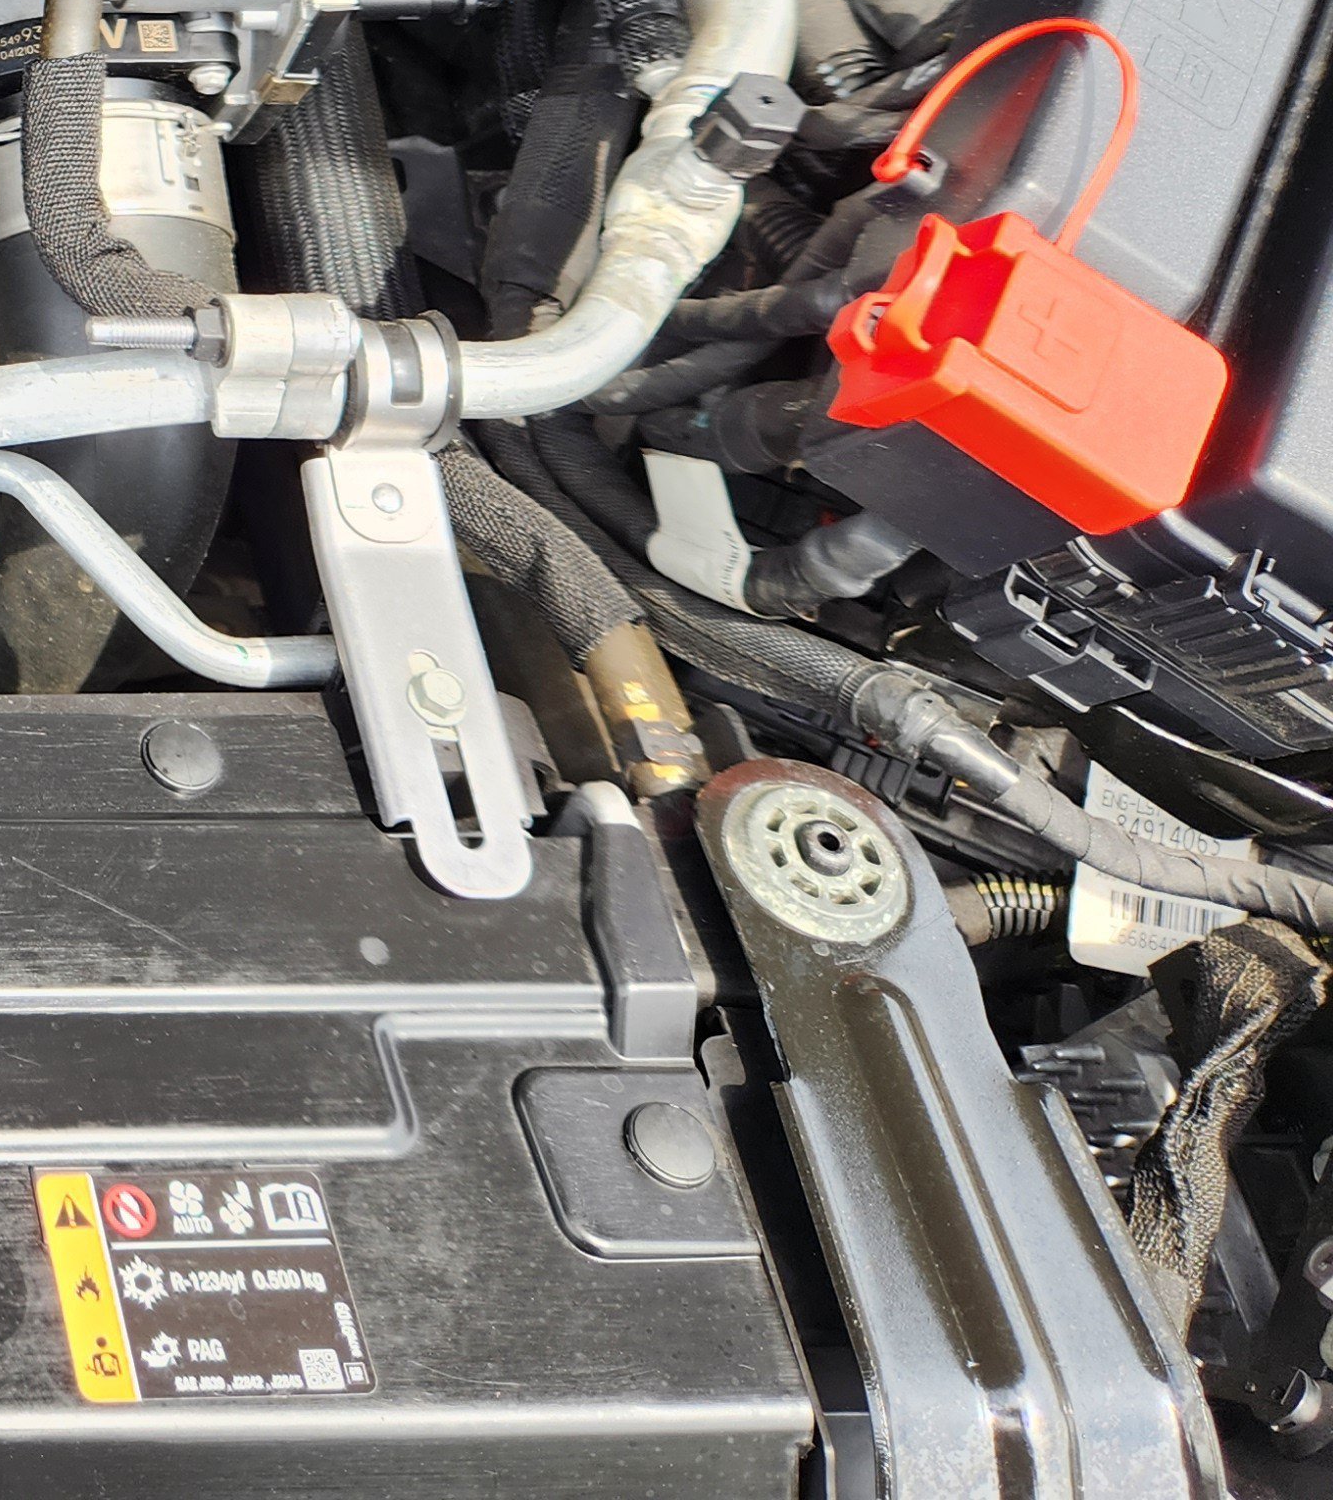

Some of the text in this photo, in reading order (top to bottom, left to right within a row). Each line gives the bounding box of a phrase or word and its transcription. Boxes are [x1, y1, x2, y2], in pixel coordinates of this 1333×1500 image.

[172, 1214, 214, 1235] AUTO
[169, 1269, 248, 1296] R-1234yf
[300, 1268, 328, 1293] kg
[187, 1337, 228, 1362] PAG
